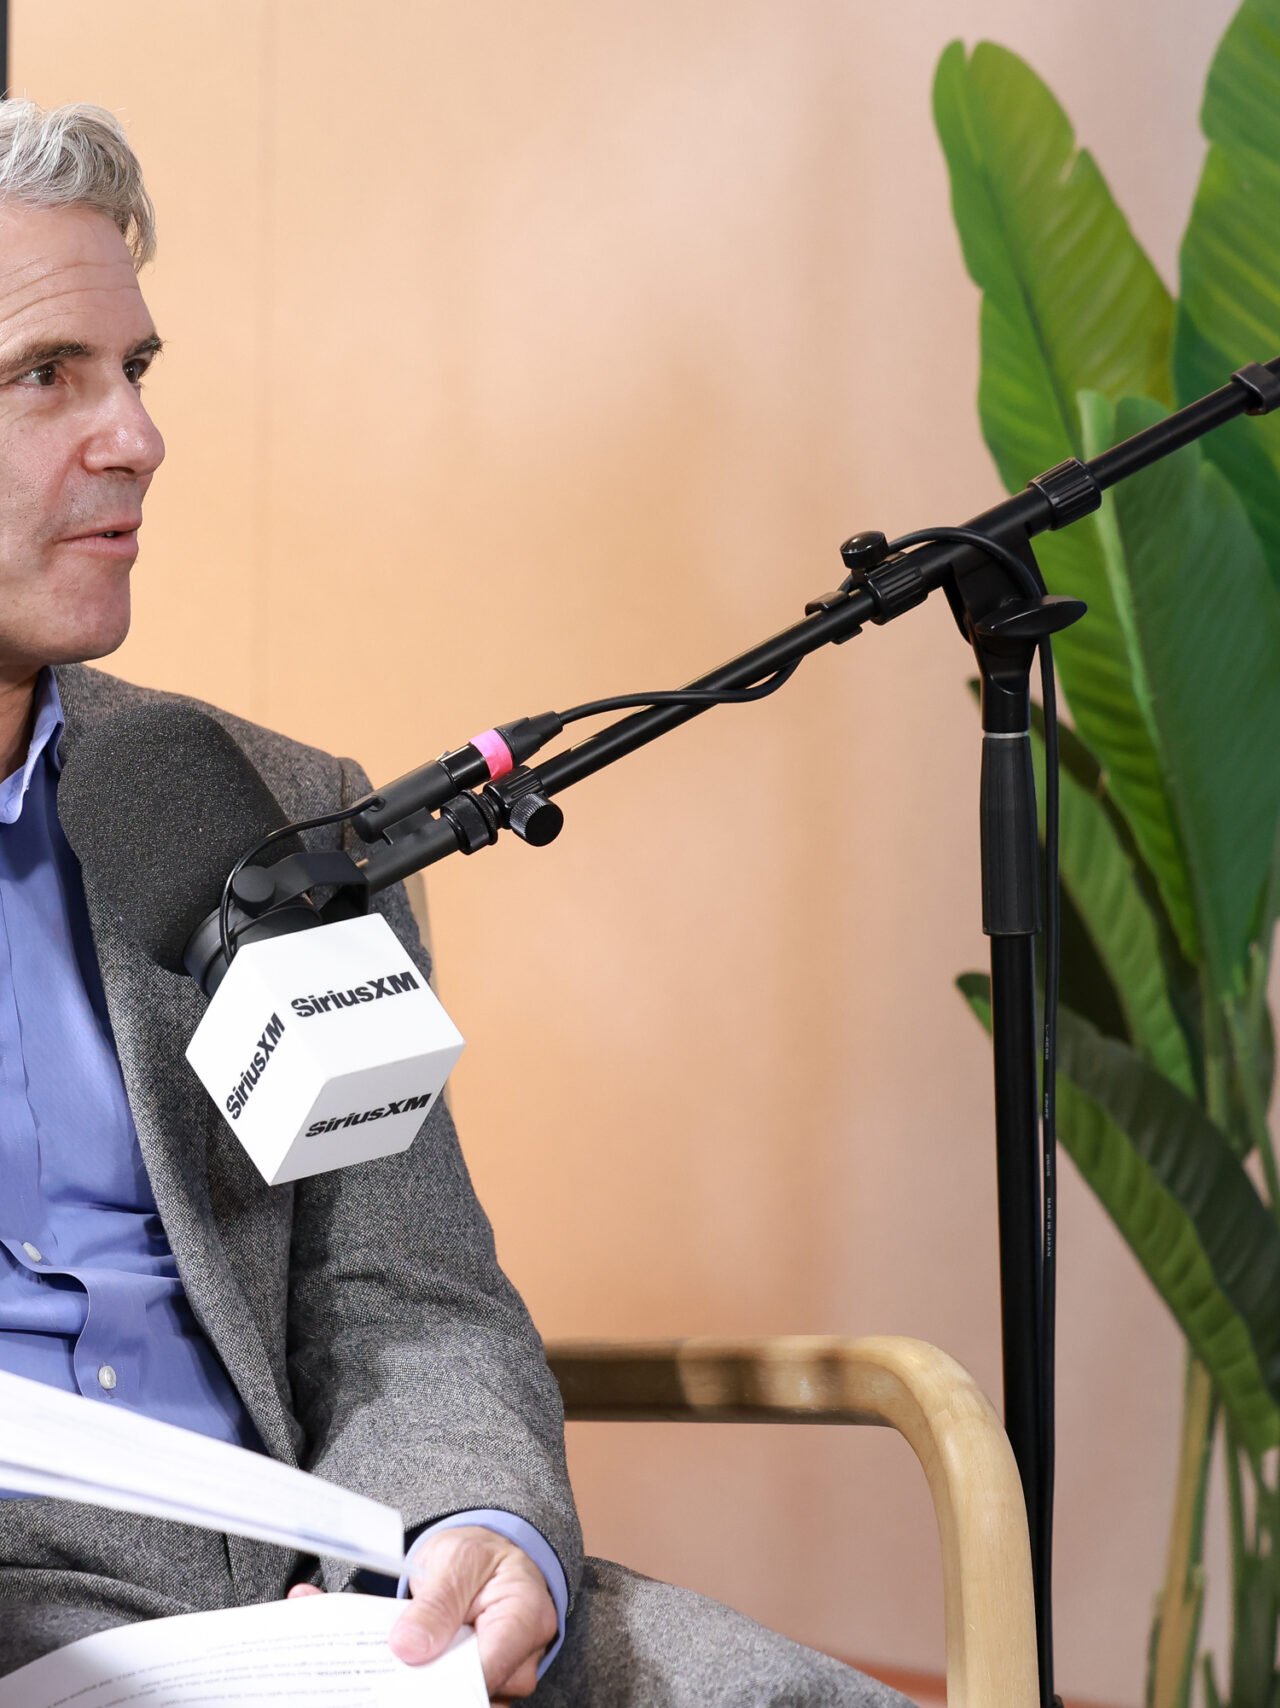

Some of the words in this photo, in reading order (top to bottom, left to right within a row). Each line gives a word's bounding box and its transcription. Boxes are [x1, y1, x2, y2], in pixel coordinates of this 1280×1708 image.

[291, 971, 420, 1018] SiriusXM
[226, 1012, 285, 1120] SiriusXM
[305, 1092, 432, 1138] SiriusXM
